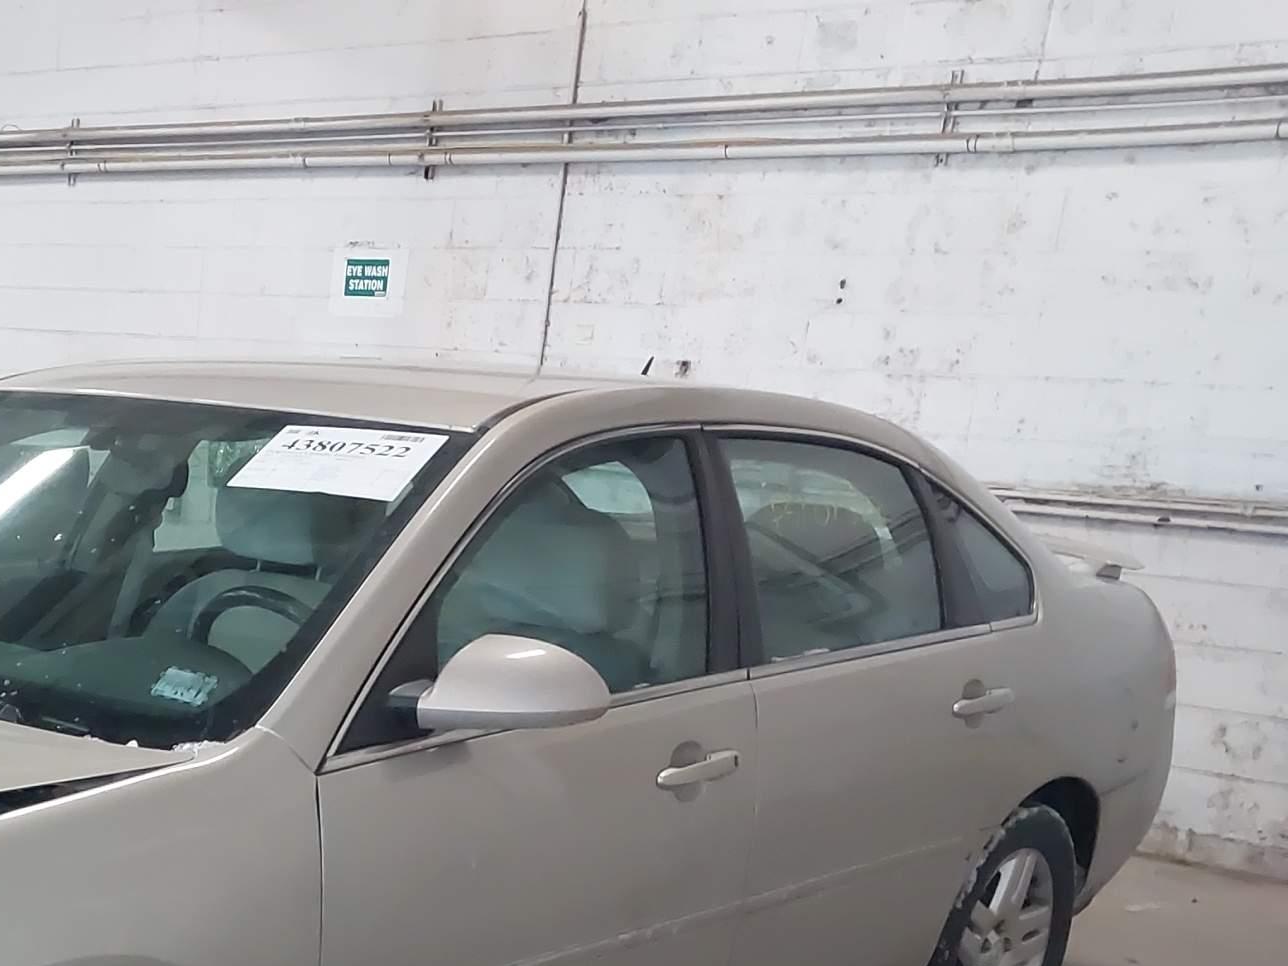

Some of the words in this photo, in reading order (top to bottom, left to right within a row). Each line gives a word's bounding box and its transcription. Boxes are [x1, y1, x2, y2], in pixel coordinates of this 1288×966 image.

[347, 265, 364, 276] EYE
[365, 265, 388, 277] WASH
[349, 279, 384, 291] STATION
[282, 438, 412, 458] 43807522
